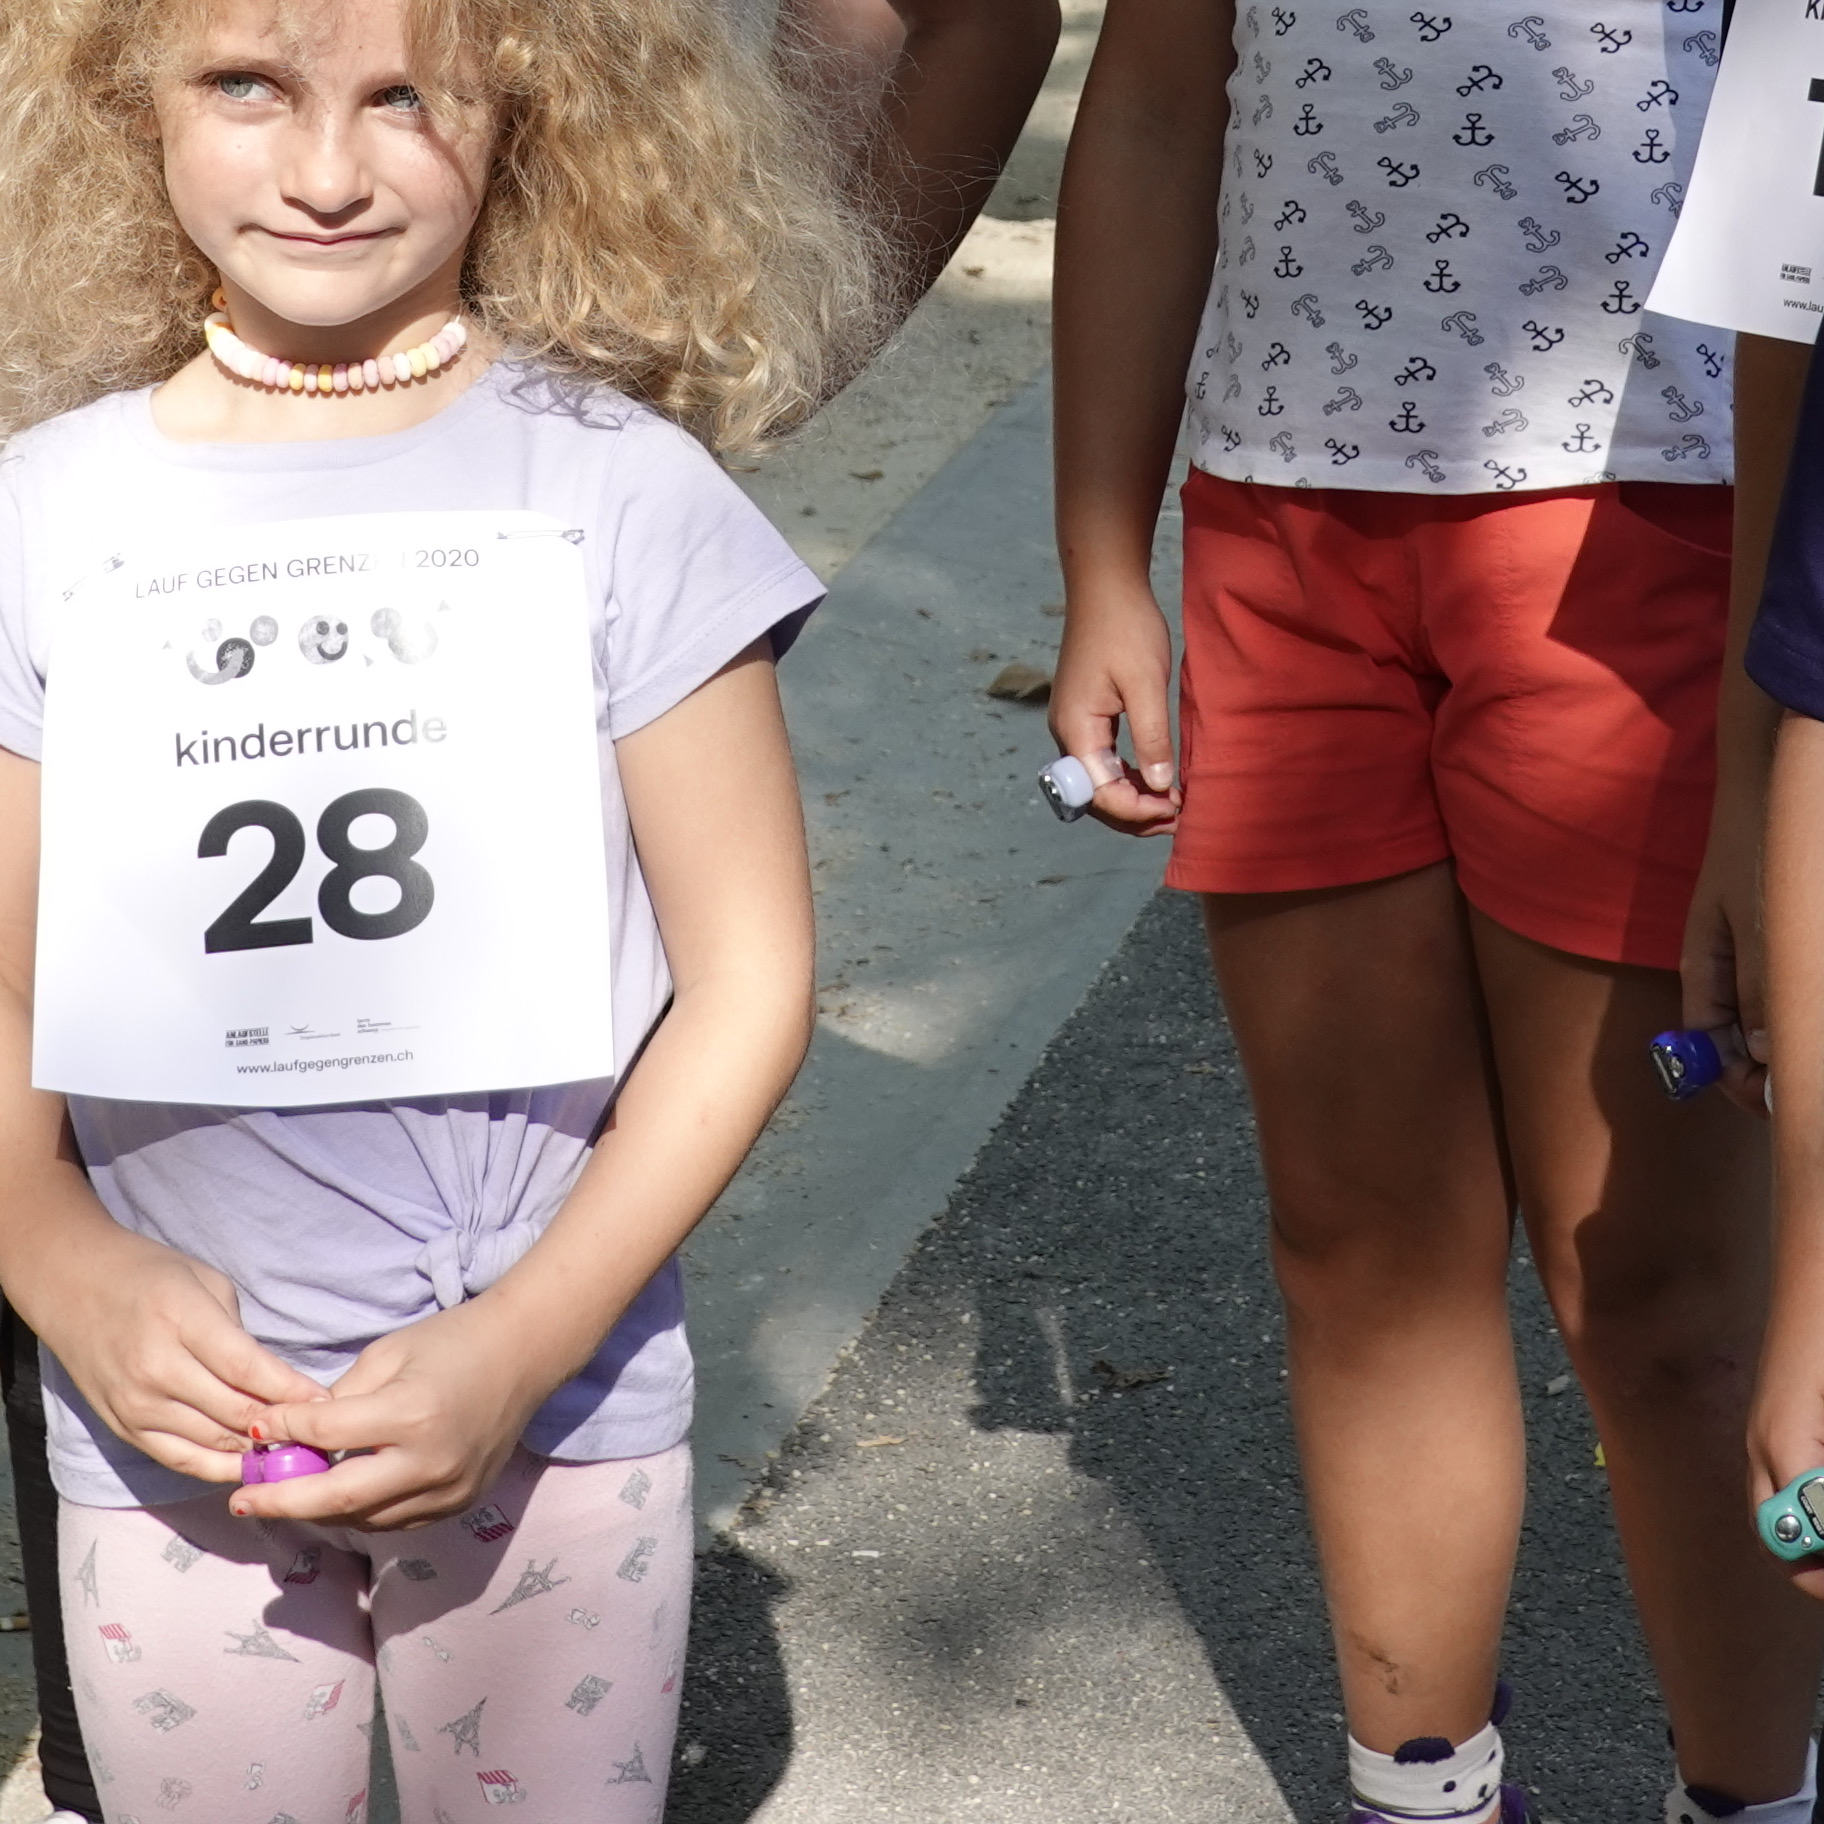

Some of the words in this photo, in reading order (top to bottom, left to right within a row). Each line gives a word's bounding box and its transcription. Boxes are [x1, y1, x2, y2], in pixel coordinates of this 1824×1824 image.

[135, 571, 188, 599] LAUF
[196, 562, 278, 590] GEGEN
[286, 552, 408, 579] GRENZ
[415, 548, 479, 569] 2020
[174, 709, 447, 767] kinderrunde
[197, 787, 435, 954] 28
[237, 1049, 414, 1074] www.laufgegengrenzen.ch
